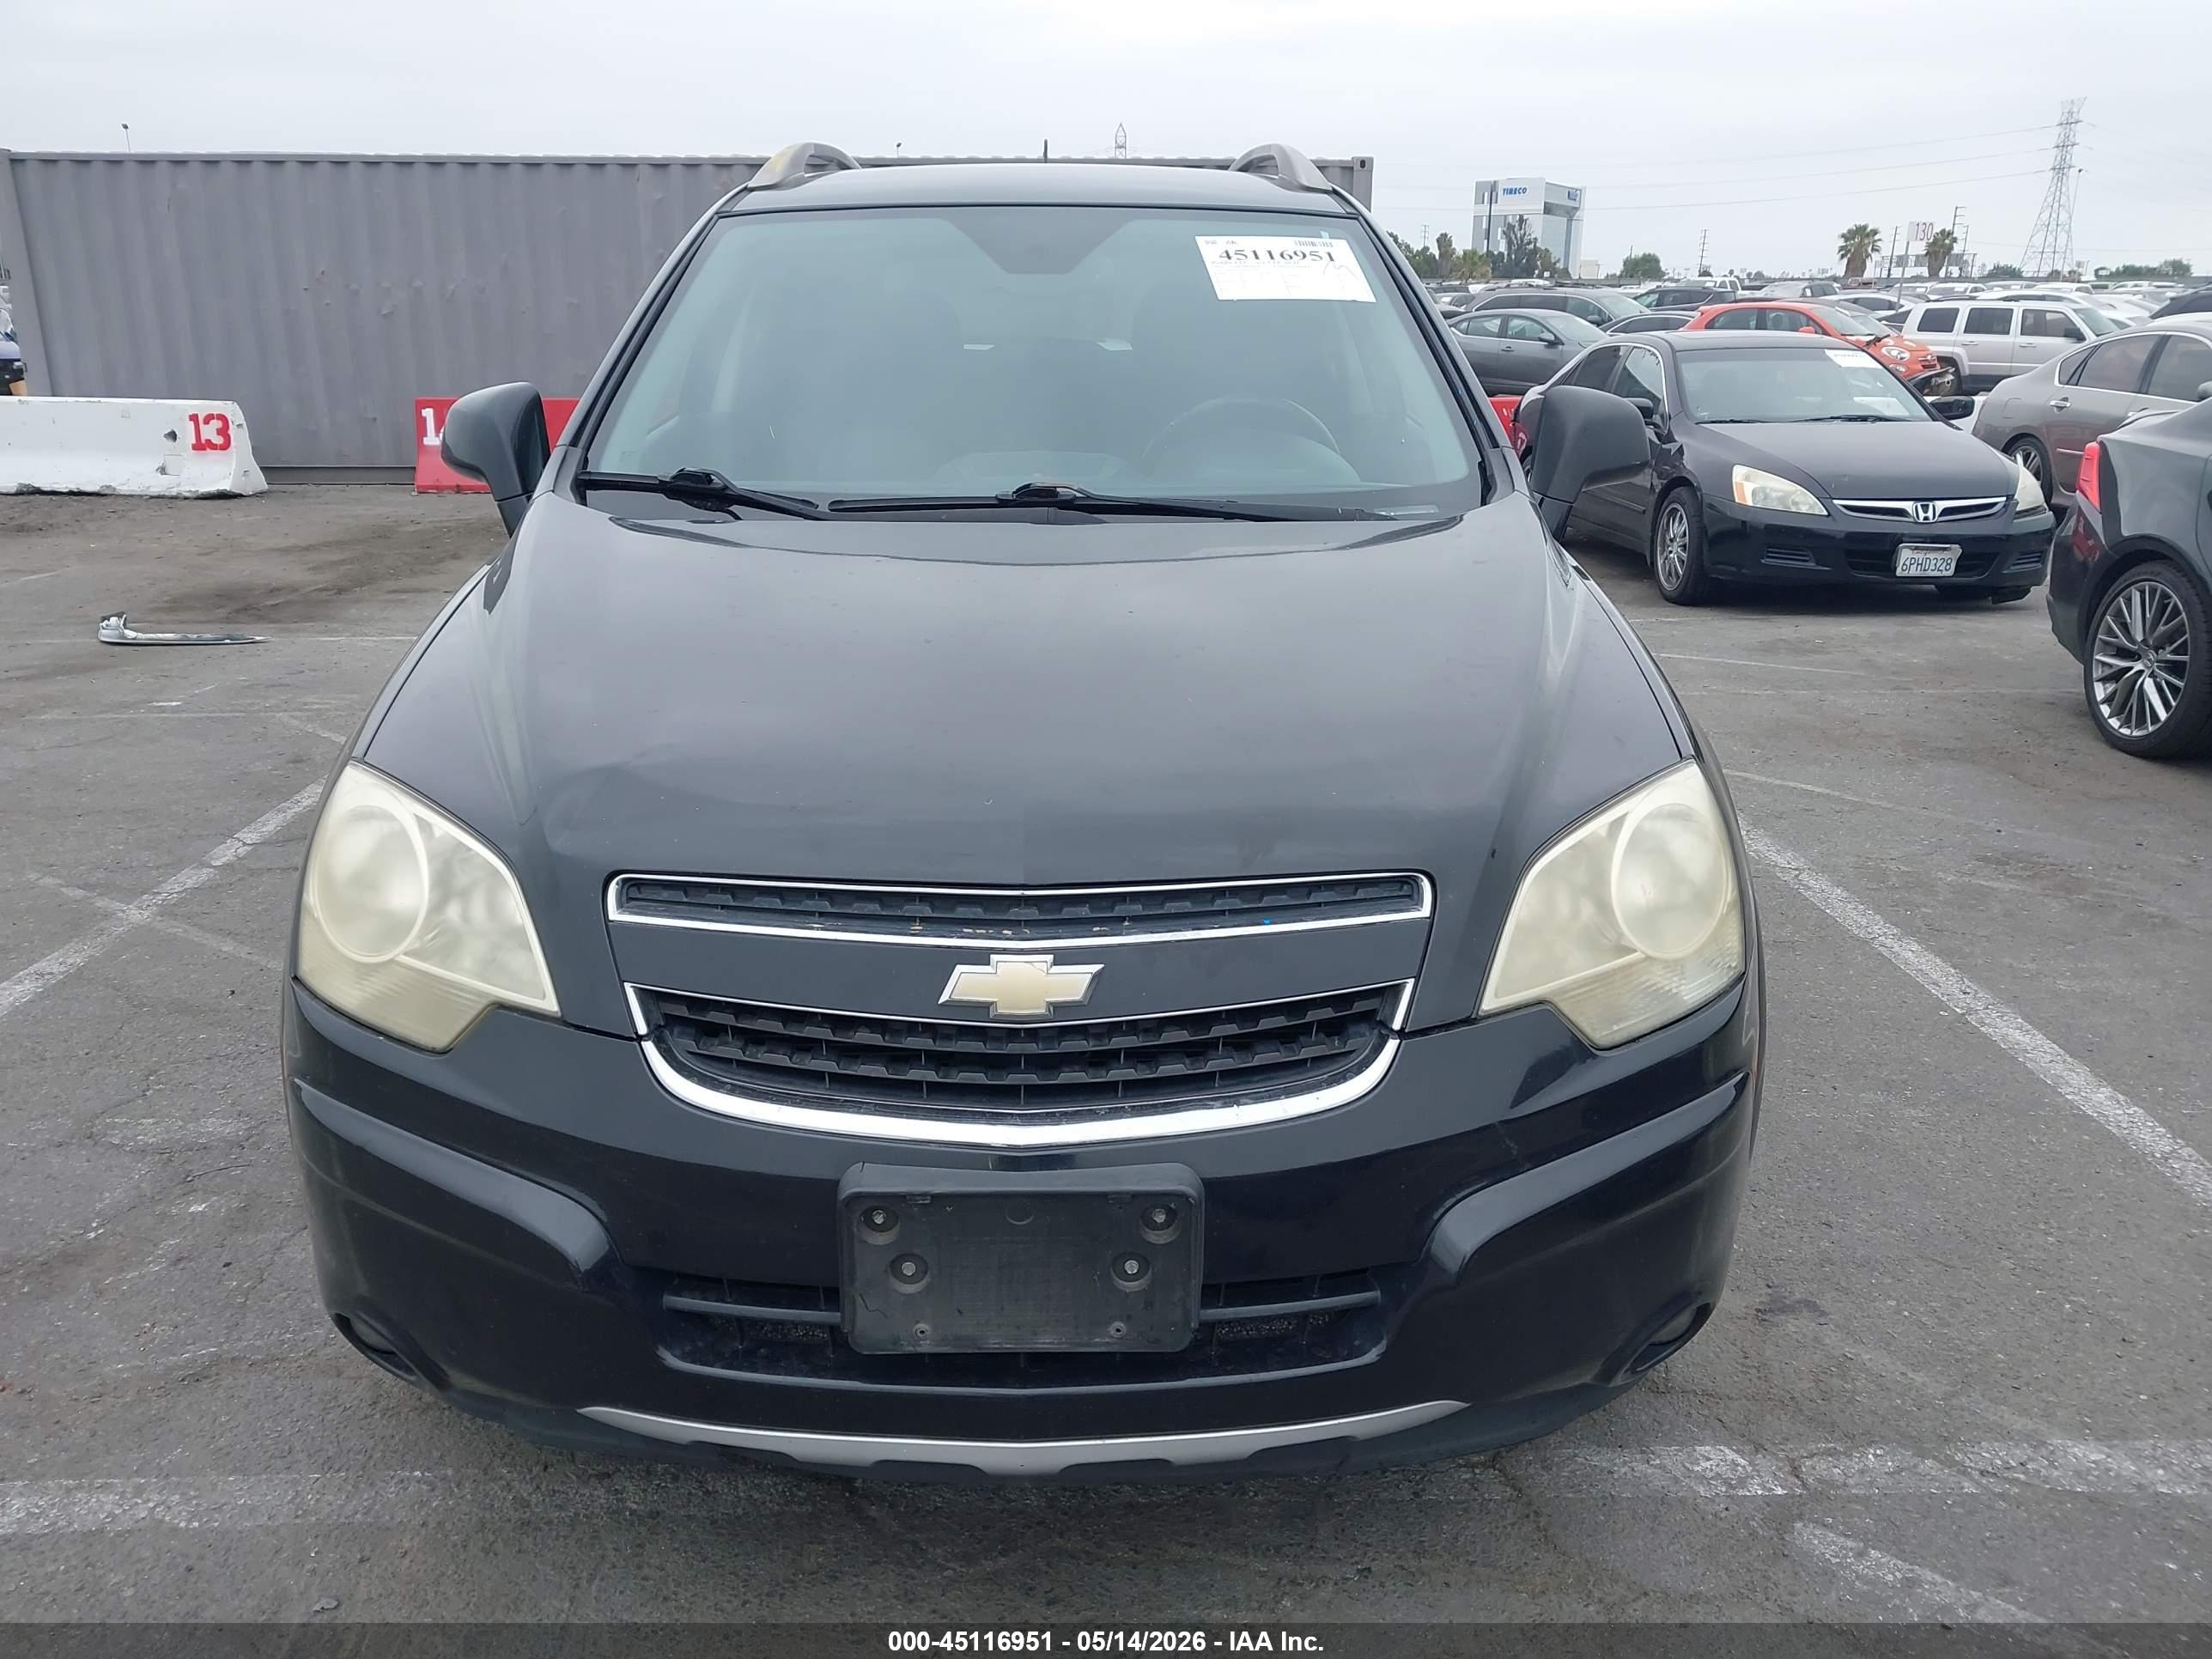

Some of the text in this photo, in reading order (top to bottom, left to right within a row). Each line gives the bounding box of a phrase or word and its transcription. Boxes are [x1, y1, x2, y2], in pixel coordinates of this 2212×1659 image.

[1502, 187, 1528, 197] TIRECO
[1915, 222, 1934, 241] 130
[1218, 249, 1335, 262] 45116951
[188, 412, 232, 452] 13
[421, 407, 445, 446] 1
[1900, 556, 1954, 573] 6PHD328
